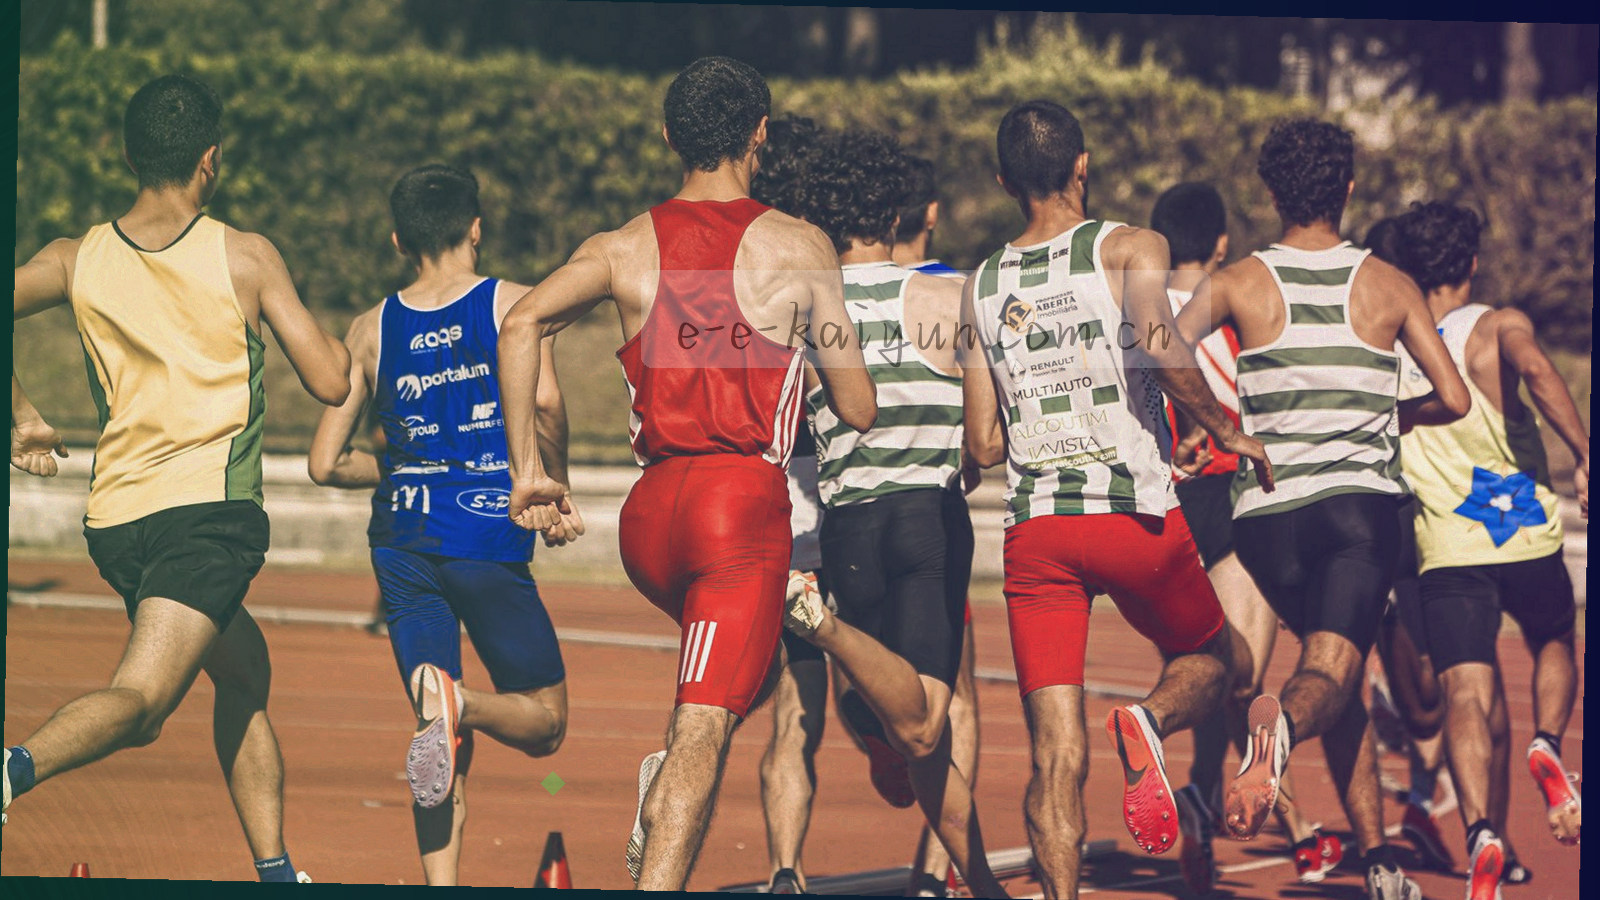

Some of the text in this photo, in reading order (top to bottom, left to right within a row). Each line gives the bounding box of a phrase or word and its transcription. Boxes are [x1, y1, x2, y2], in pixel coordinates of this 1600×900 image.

[1036, 295, 1077, 312] ABERTA
[1030, 356, 1075, 372] RENAULT
[421, 363, 490, 391] portalum
[1013, 376, 1093, 403] MULTIAUTO
[472, 401, 497, 421] NF
[407, 423, 440, 442] group
[457, 418, 504, 433] NUMERFE
[1013, 409, 1109, 444] ALCOUTIM
[1027, 436, 1101, 461] INVISTA
